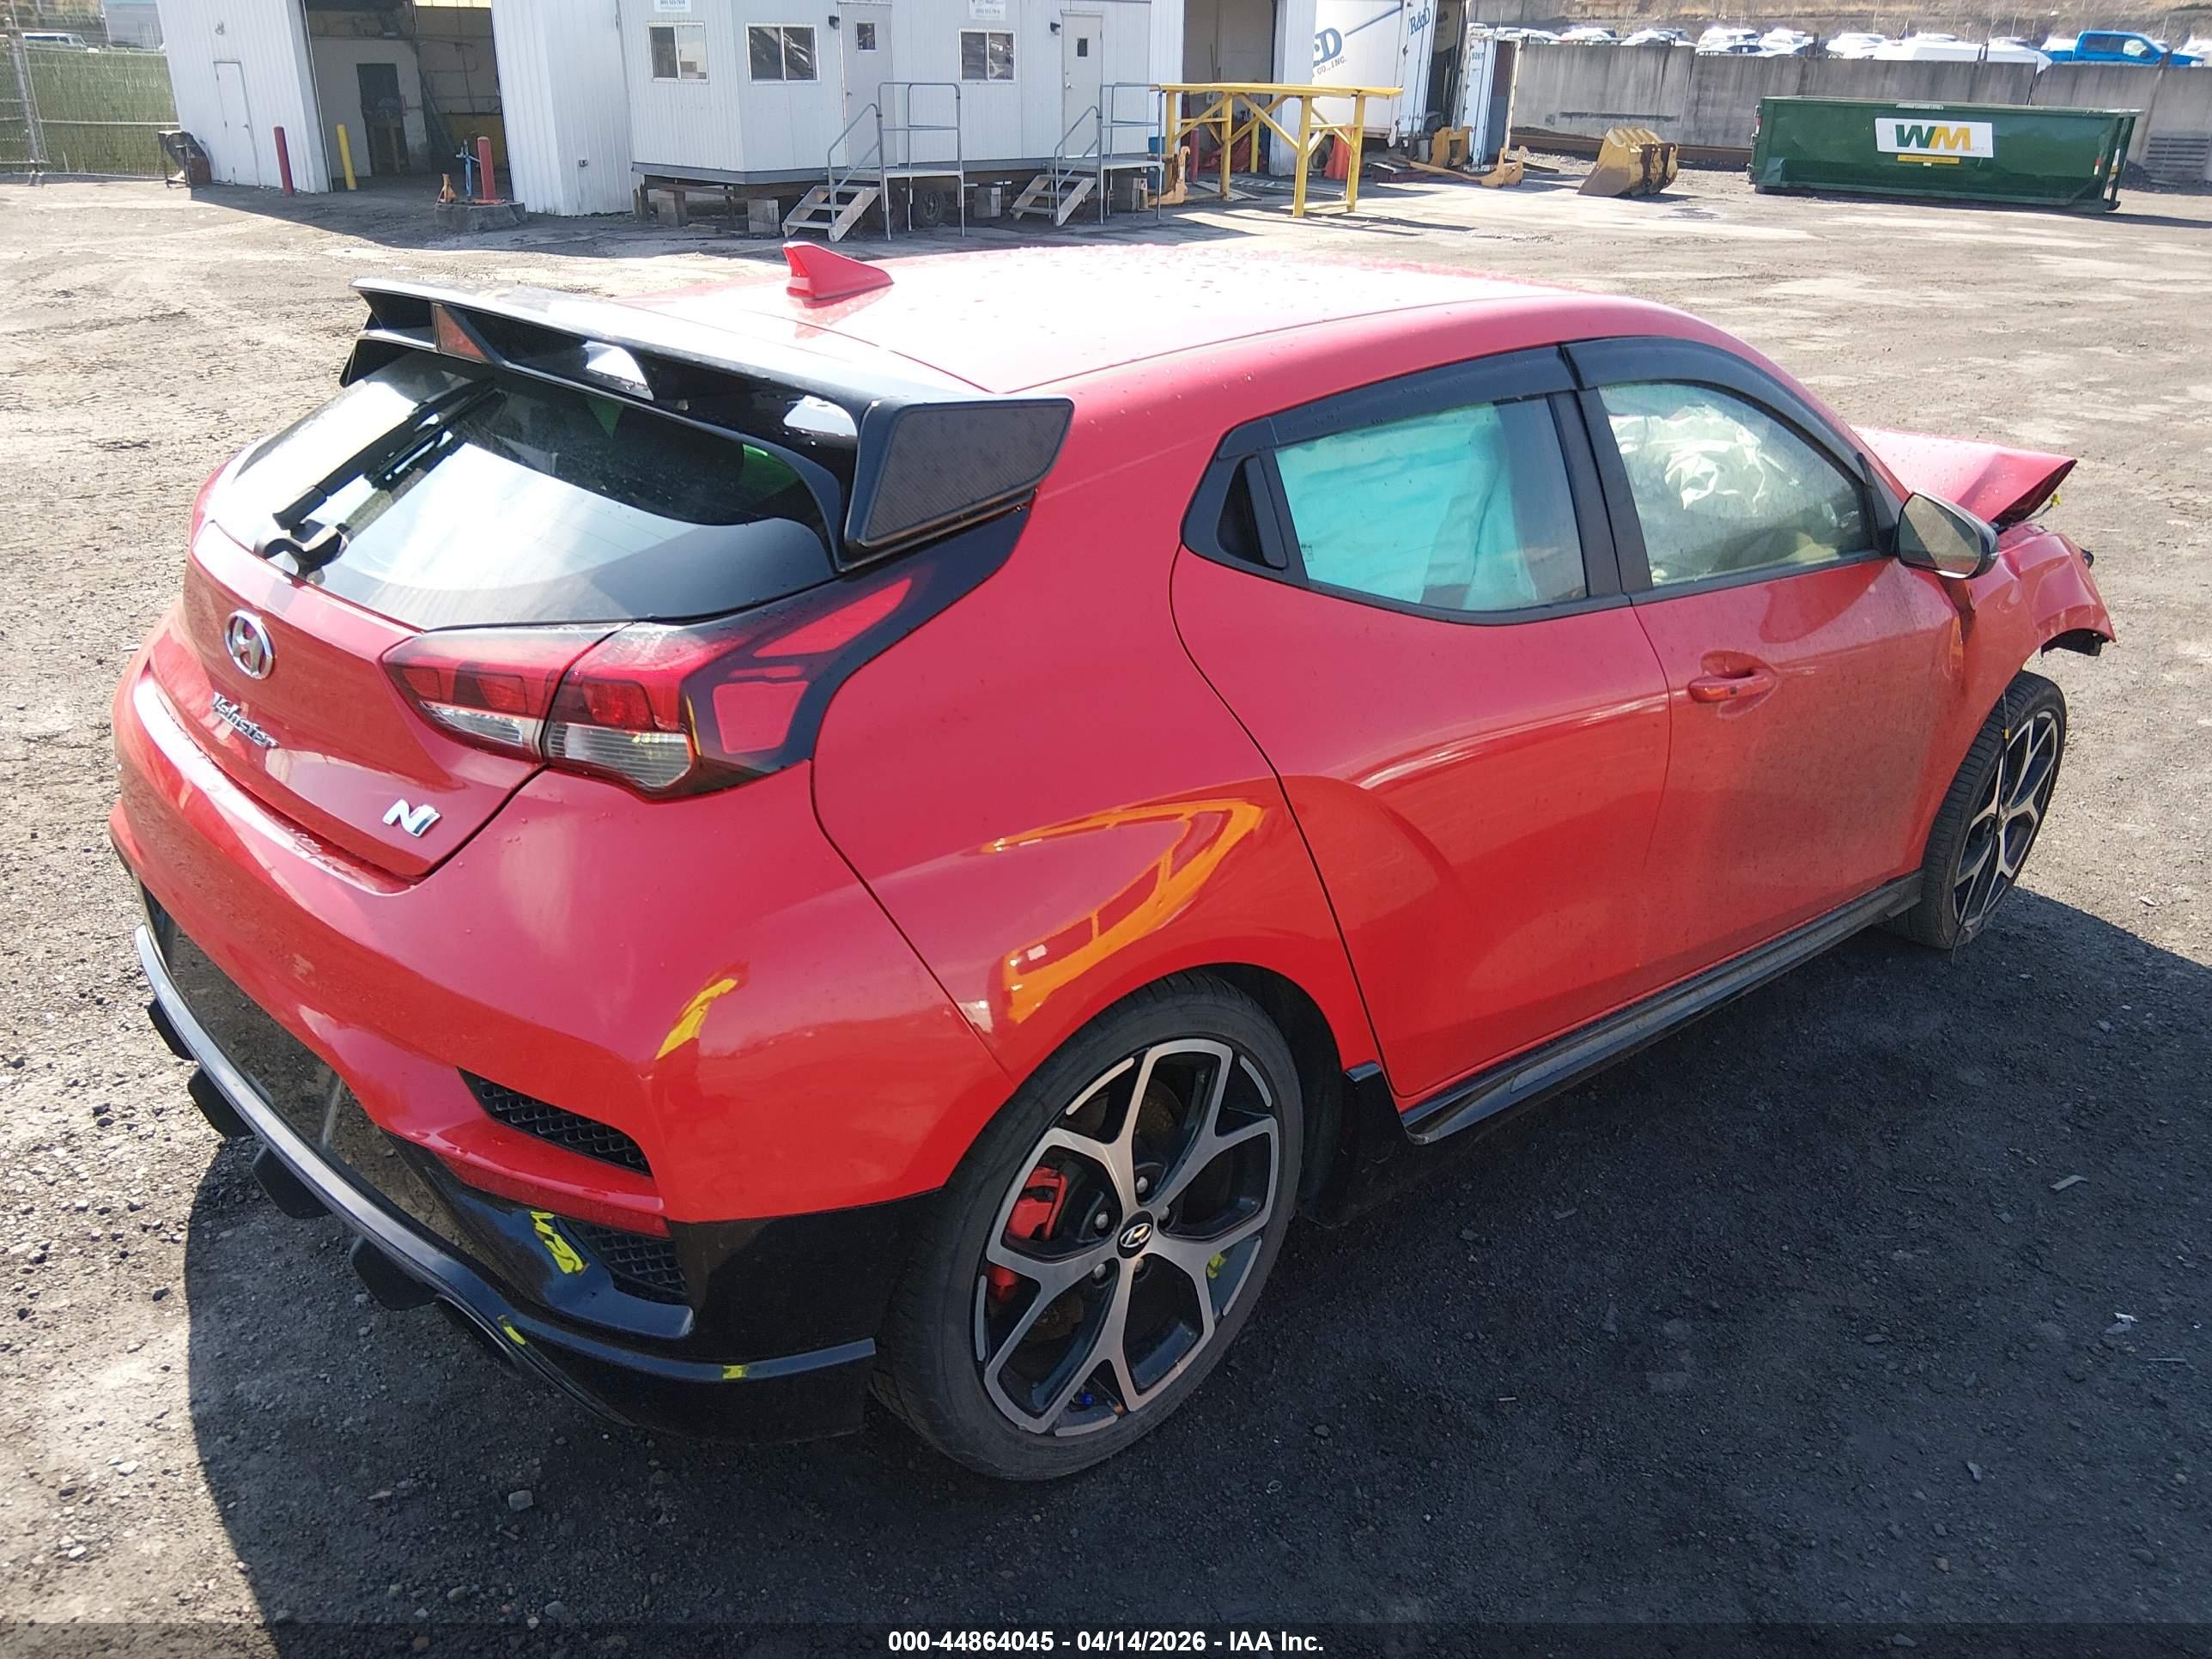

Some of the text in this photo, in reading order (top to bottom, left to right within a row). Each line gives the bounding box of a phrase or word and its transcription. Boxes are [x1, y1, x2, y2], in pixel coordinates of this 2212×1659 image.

[1409, 6, 1431, 35] R&D
[1895, 124, 1972, 152] WM
[381, 798, 441, 838] N
